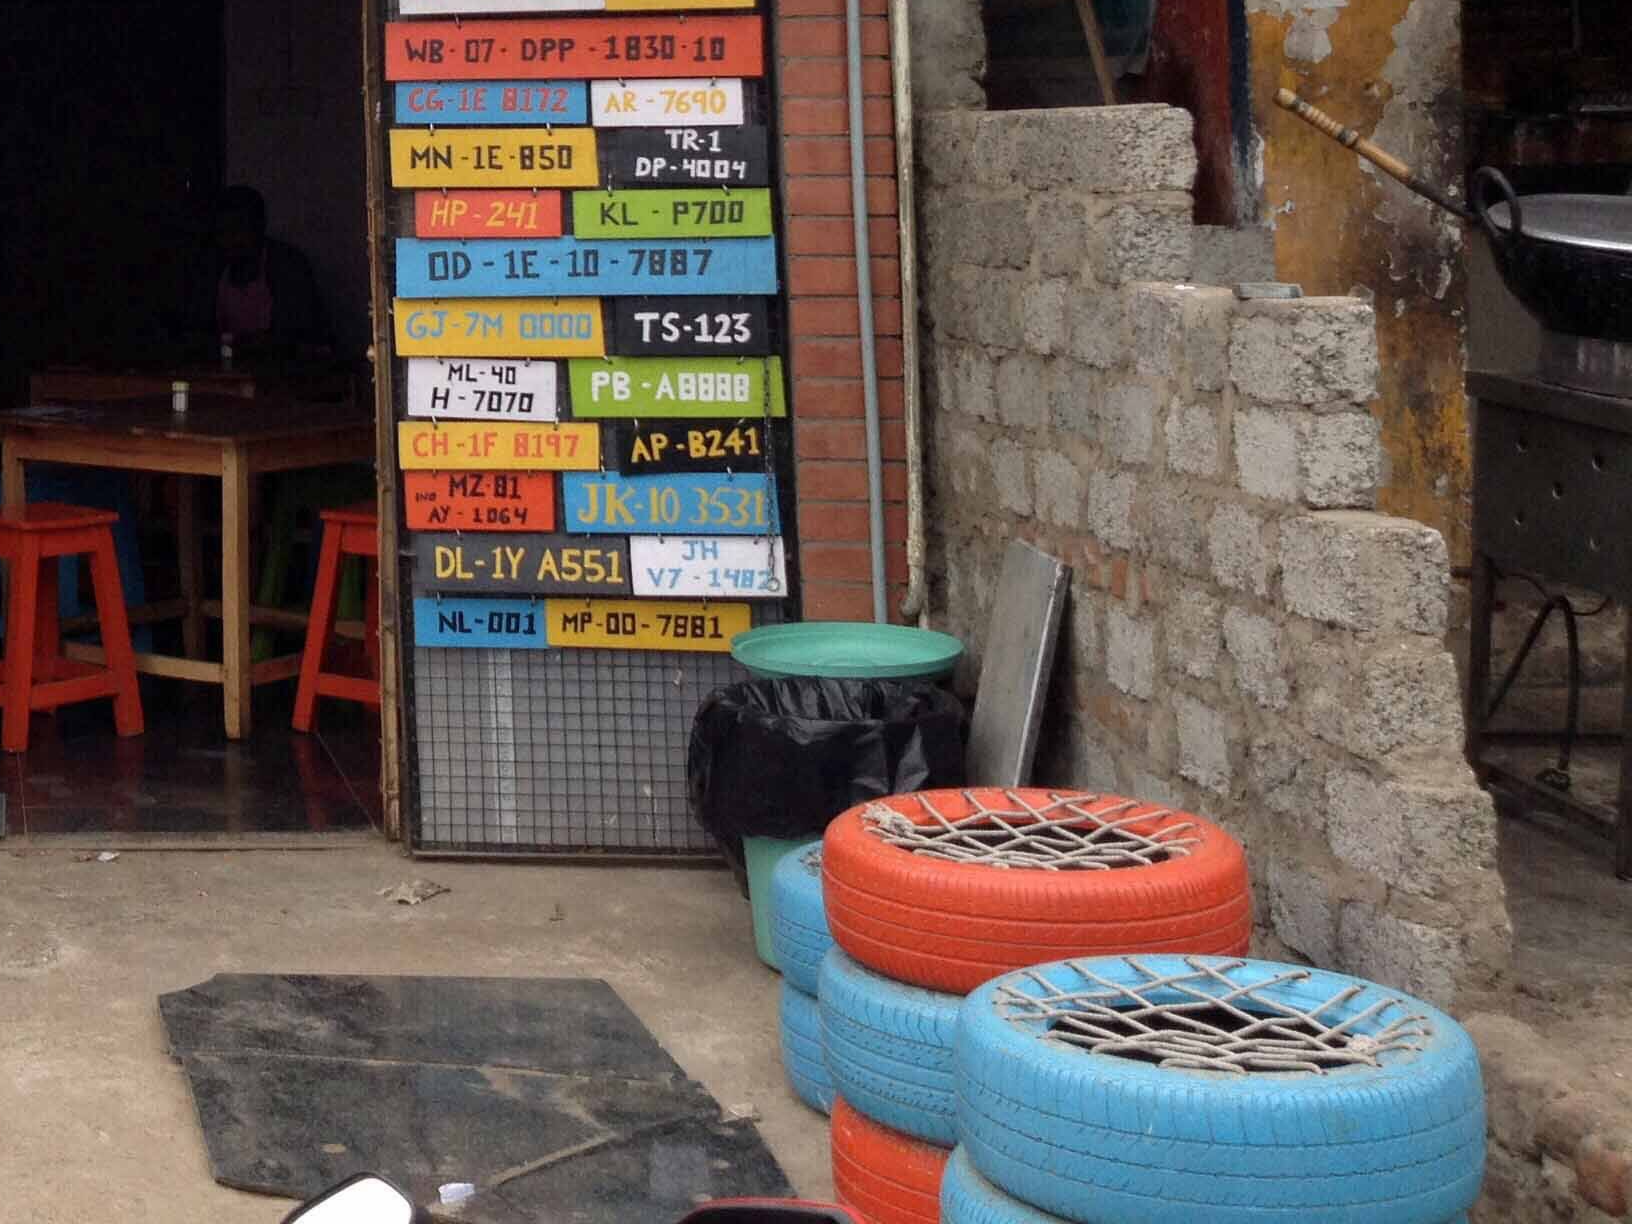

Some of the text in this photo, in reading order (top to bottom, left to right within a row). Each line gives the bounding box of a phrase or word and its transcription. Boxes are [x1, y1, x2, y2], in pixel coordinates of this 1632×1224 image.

[633, 311, 753, 344] TS-123
[536, 547, 625, 584] A551
[681, 539, 719, 560] JH
